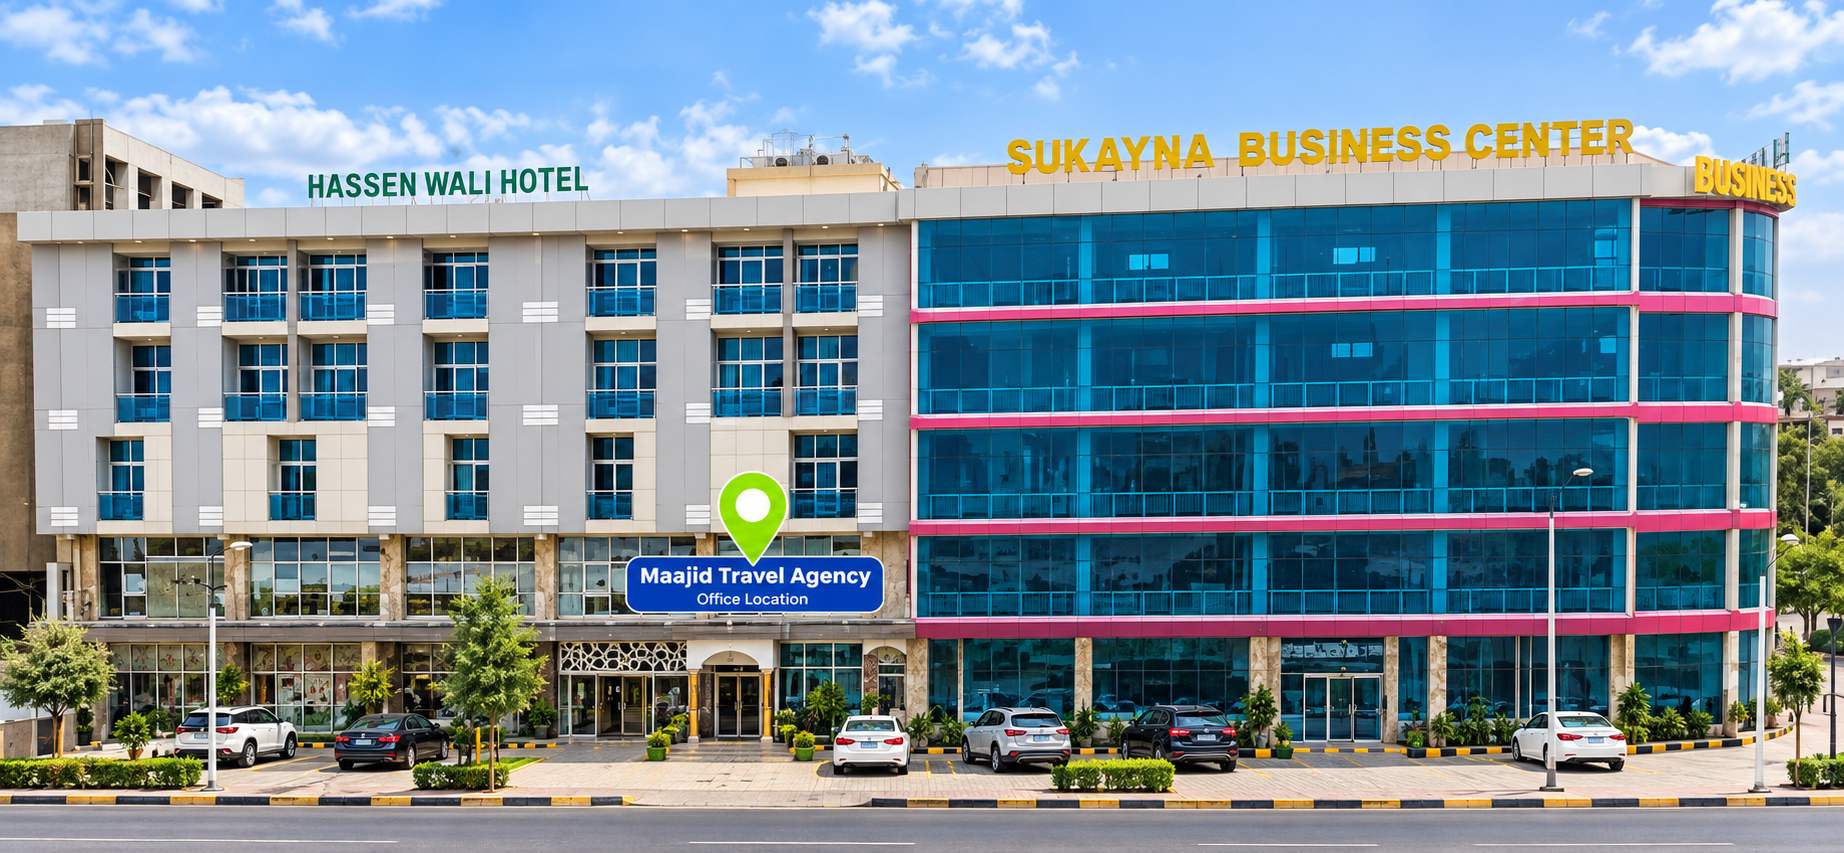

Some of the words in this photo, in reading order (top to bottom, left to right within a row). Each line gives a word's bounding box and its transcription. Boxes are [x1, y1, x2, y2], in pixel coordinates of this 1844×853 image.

[1006, 133, 1216, 175] SUKAYNA
[1238, 124, 1451, 167] BUSINESS
[1464, 119, 1634, 160] CENTER
[308, 172, 416, 198] HASSEN
[424, 170, 491, 195] WALI
[500, 166, 589, 193] HOTEL
[1695, 156, 1797, 208] BUSINESS
